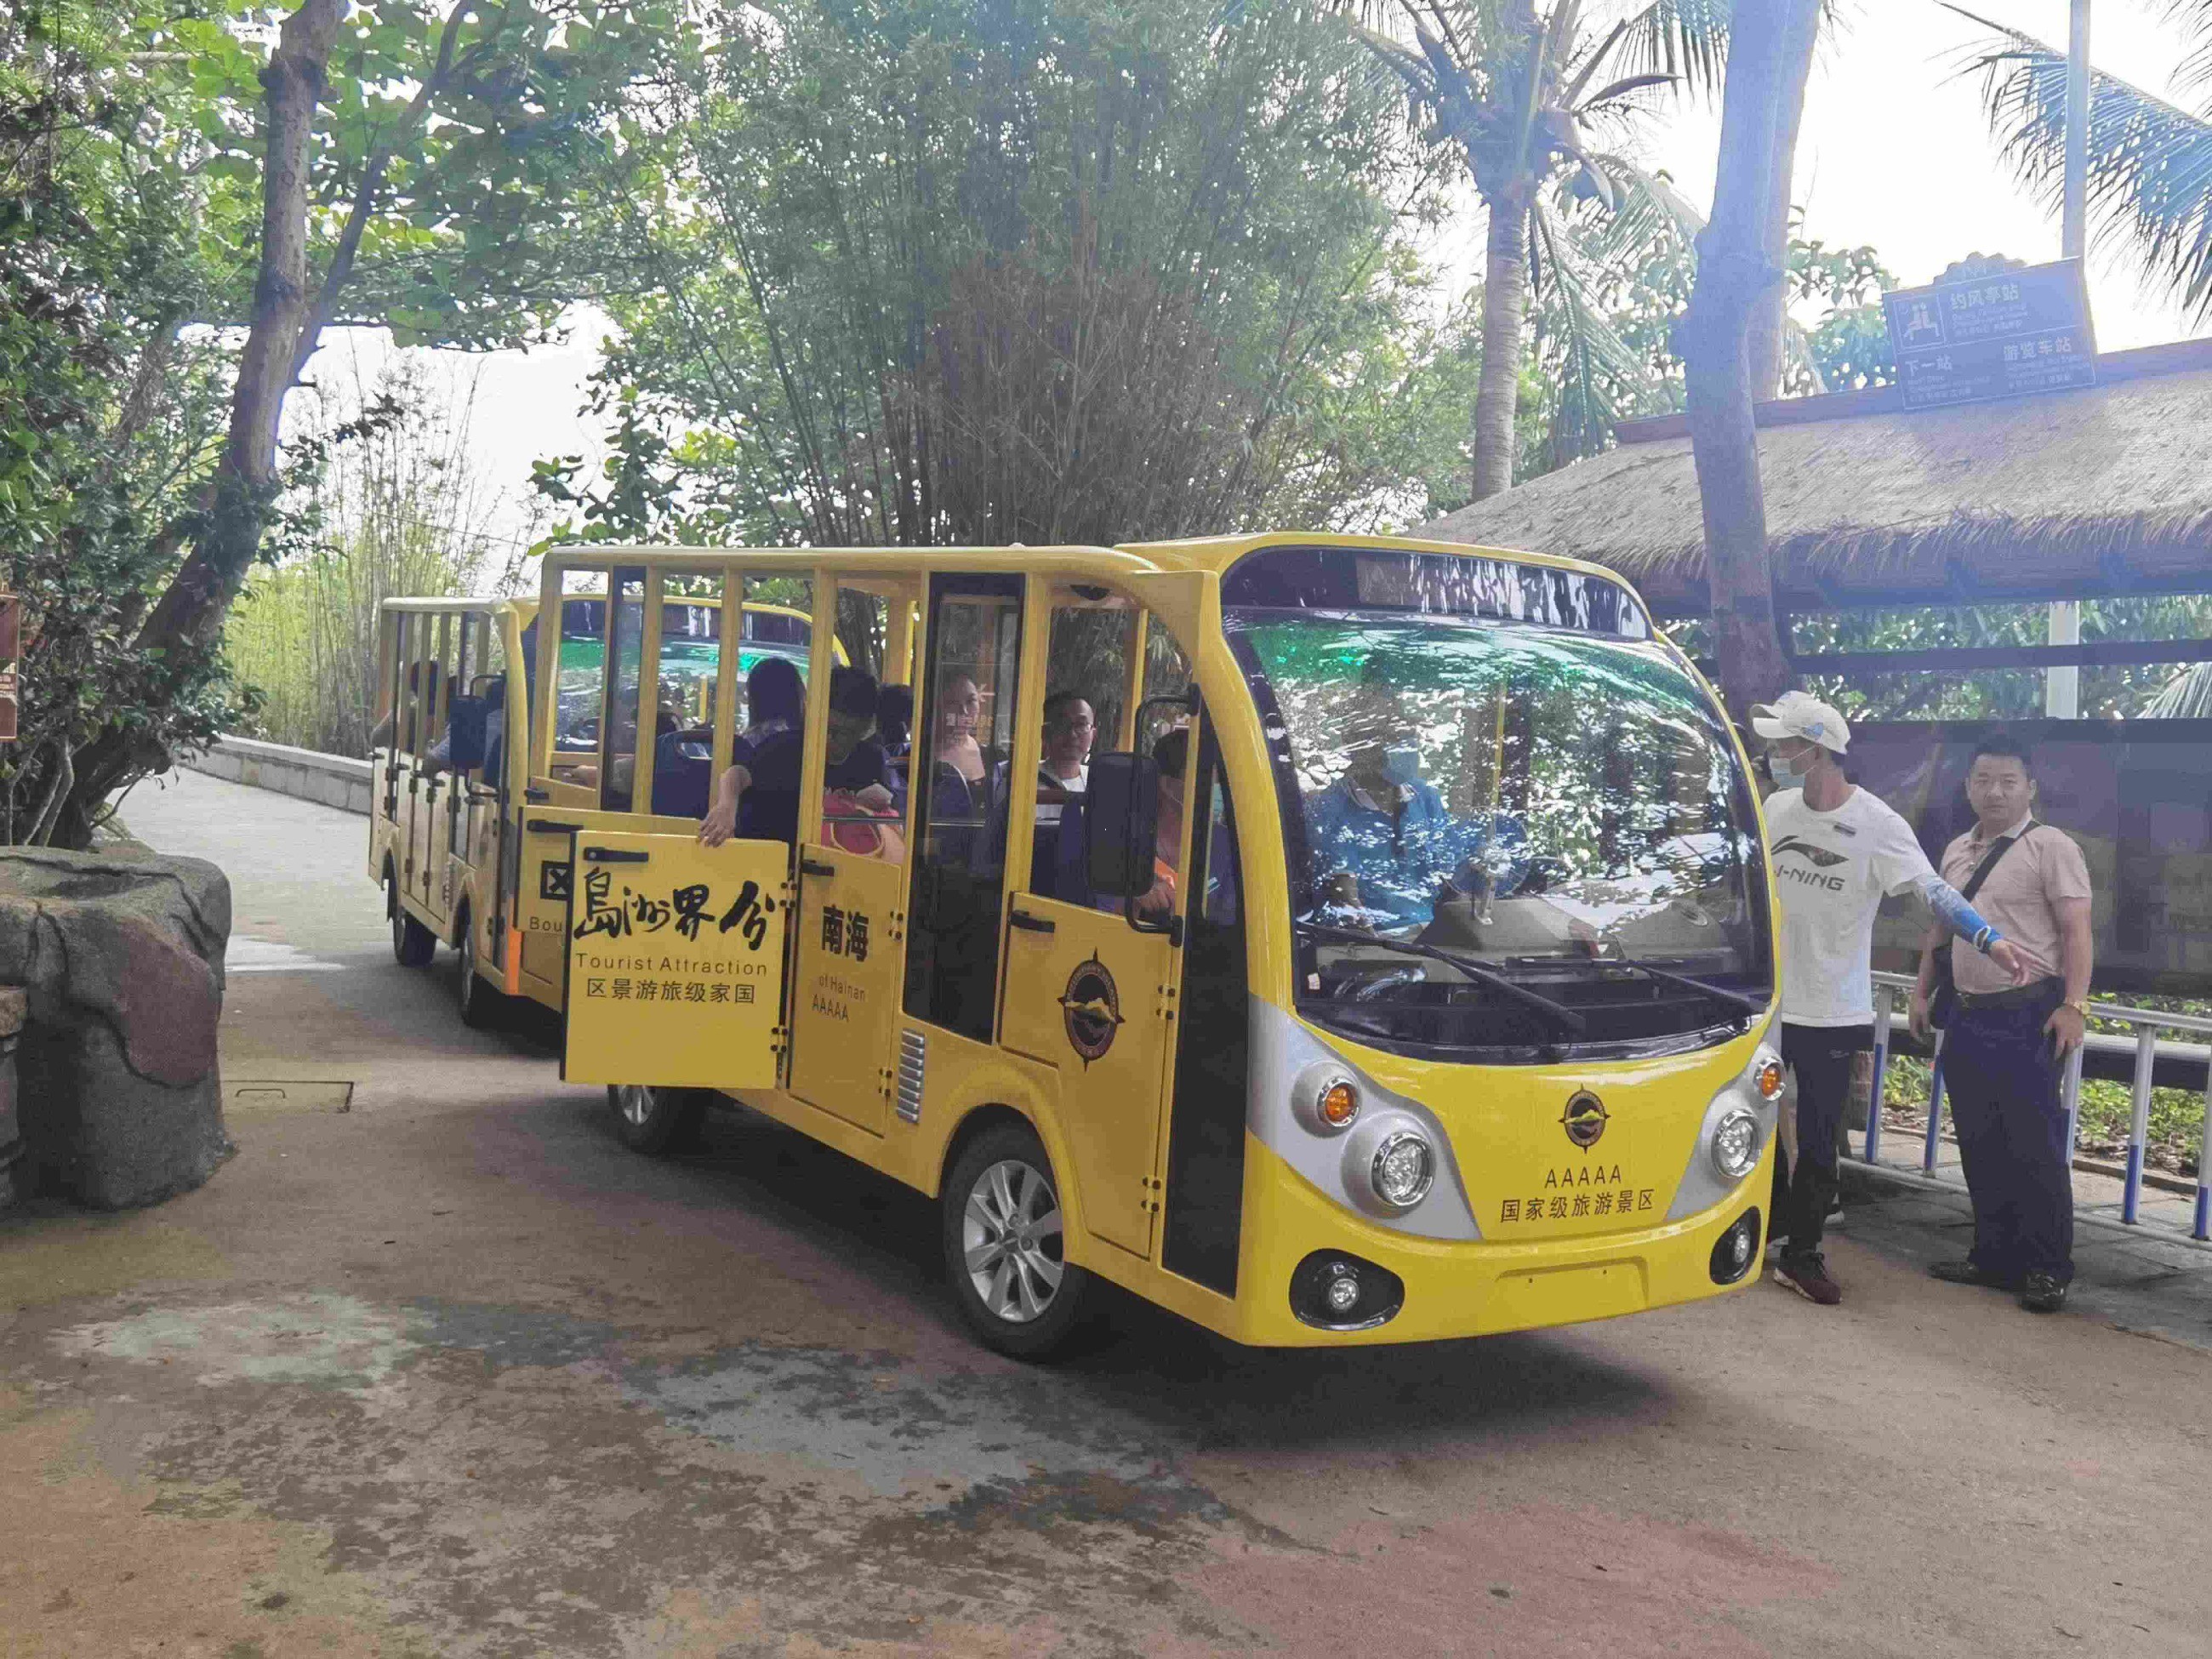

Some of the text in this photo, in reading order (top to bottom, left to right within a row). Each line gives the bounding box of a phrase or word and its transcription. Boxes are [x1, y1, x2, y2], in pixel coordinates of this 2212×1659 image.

[2004, 336, 2072, 361] 游览车站
[1905, 354, 1953, 377] 下一站
[575, 952, 767, 976] Tourist Attraction
[818, 974, 865, 1002] of Hainan
[812, 993, 849, 1023] AAAAA
[1544, 1165, 1622, 1189] AAAAA
[1500, 1189, 1655, 1223] 国家级旅游景区
